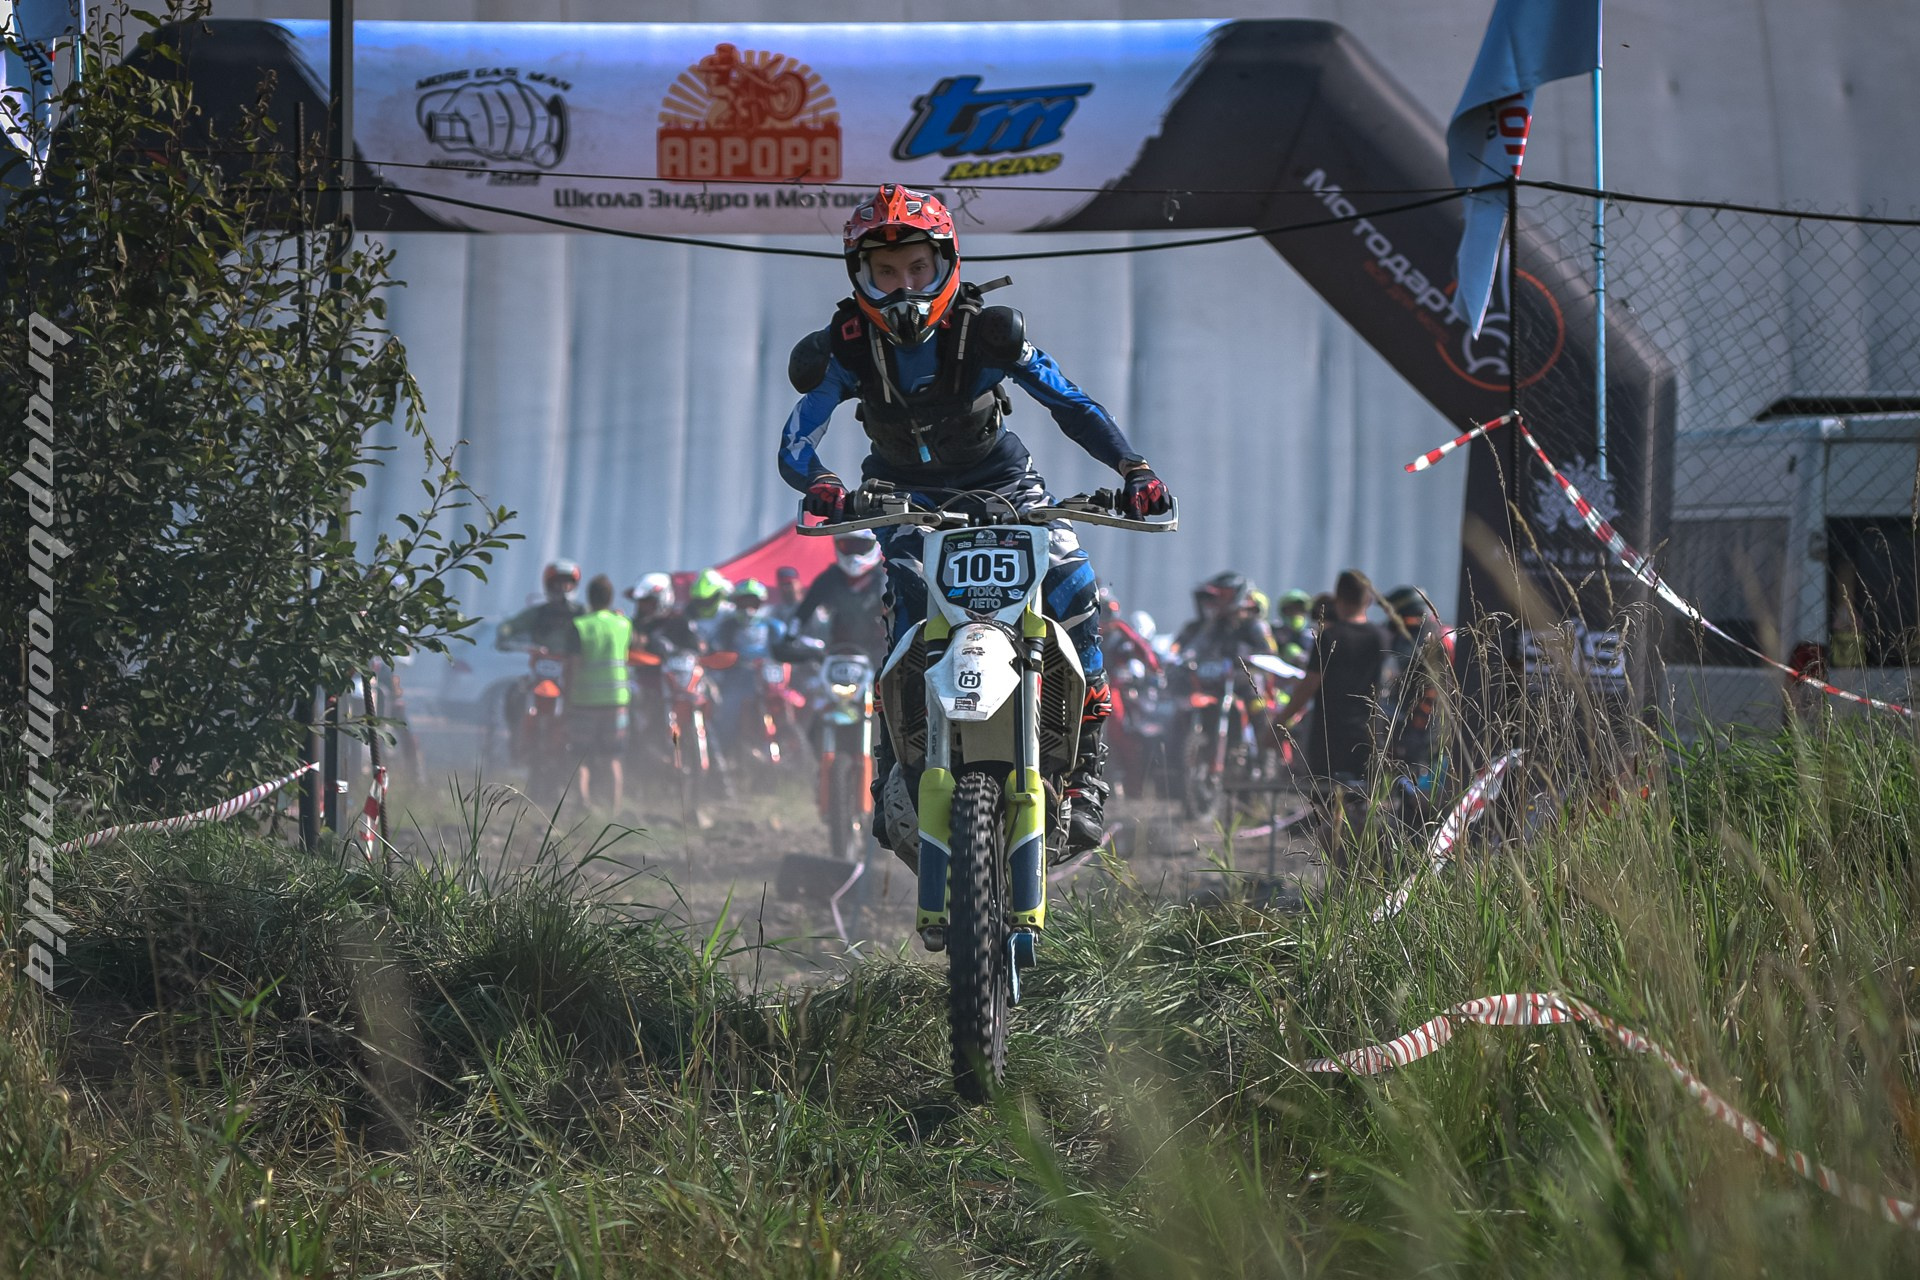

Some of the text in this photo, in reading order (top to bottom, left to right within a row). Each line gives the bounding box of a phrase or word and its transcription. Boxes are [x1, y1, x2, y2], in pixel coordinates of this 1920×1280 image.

[661, 136, 839, 177] АВРОРА
[941, 152, 1063, 181] RACING
[553, 187, 642, 208] Школа
[647, 187, 750, 211] Эндуро
[753, 192, 770, 208] и
[950, 550, 1019, 586] 105
[967, 586, 1003, 597] ПОКА
[968, 598, 1001, 609] ЛЕТО
